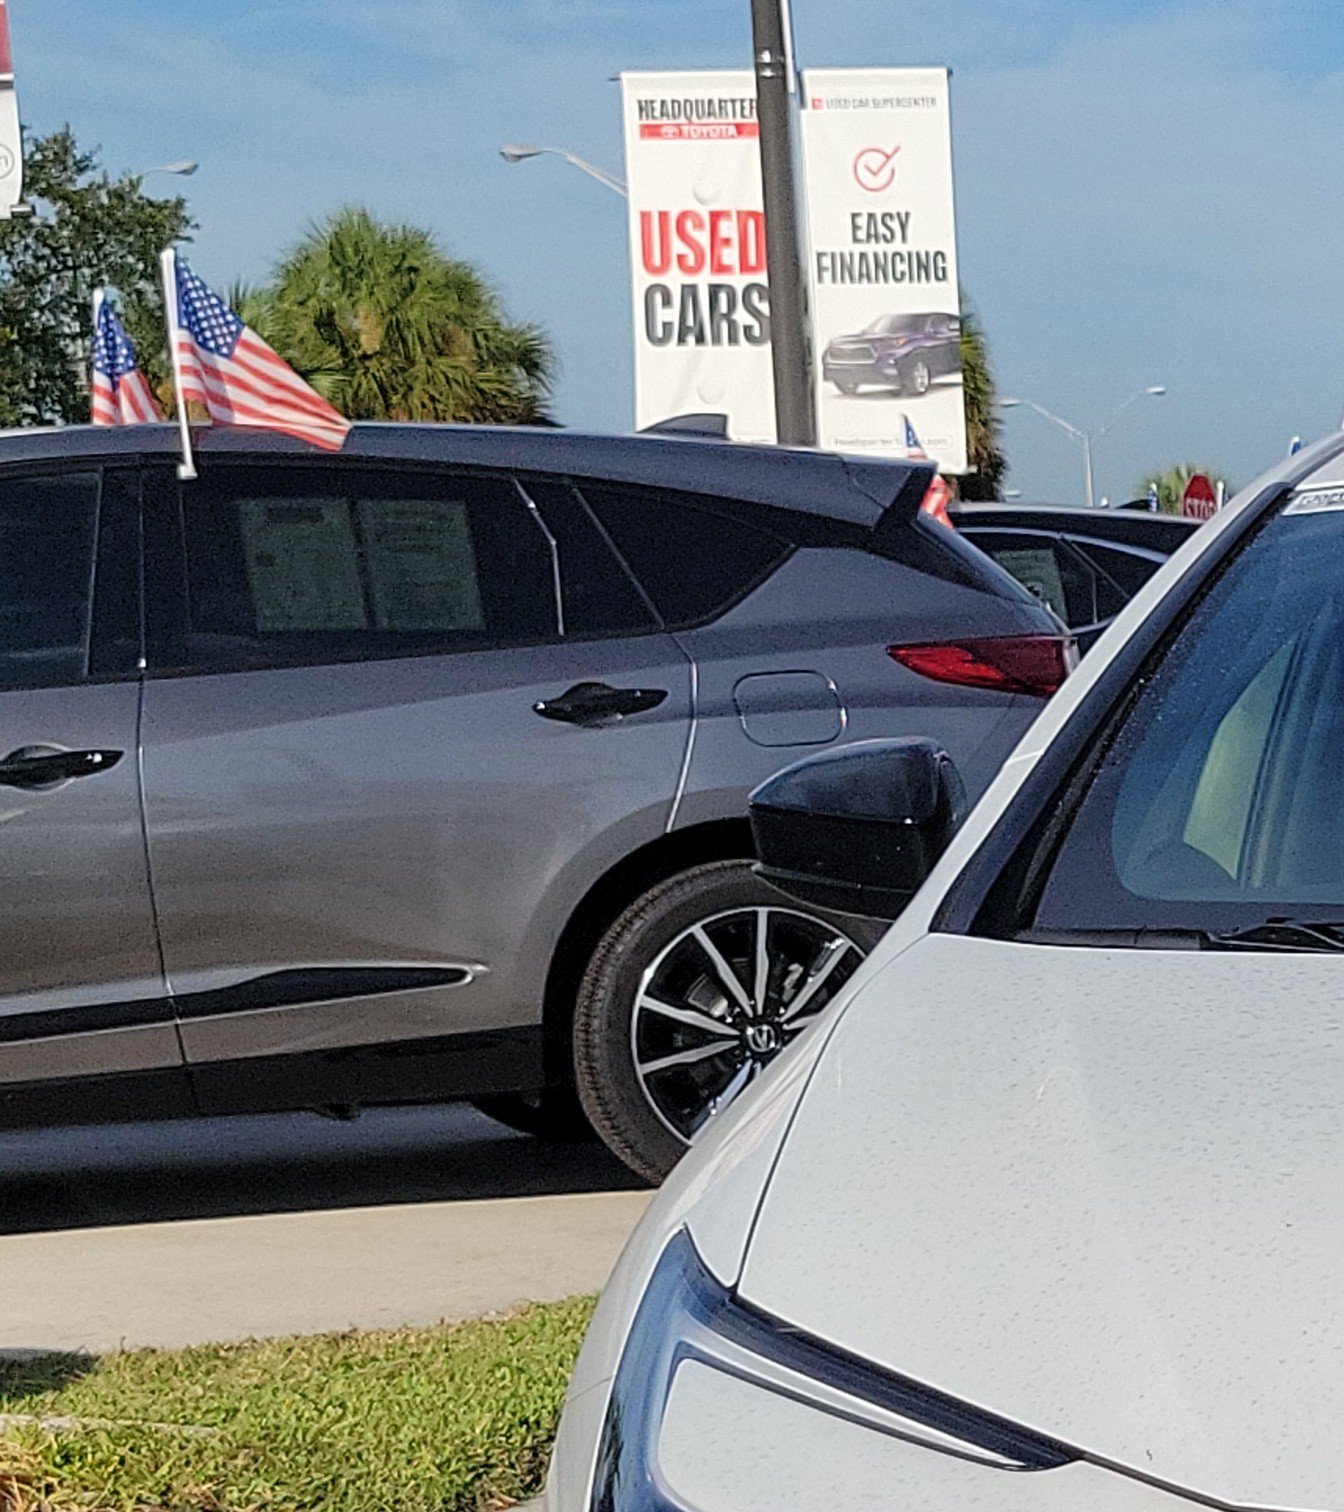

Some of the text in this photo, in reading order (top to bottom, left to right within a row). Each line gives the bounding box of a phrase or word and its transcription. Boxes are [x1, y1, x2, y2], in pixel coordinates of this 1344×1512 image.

[682, 124, 740, 139] TOYOTA
[640, 210, 767, 275] USED
[851, 211, 910, 244] EASY
[816, 250, 948, 284] FINANCING
[644, 283, 771, 346] CARS
